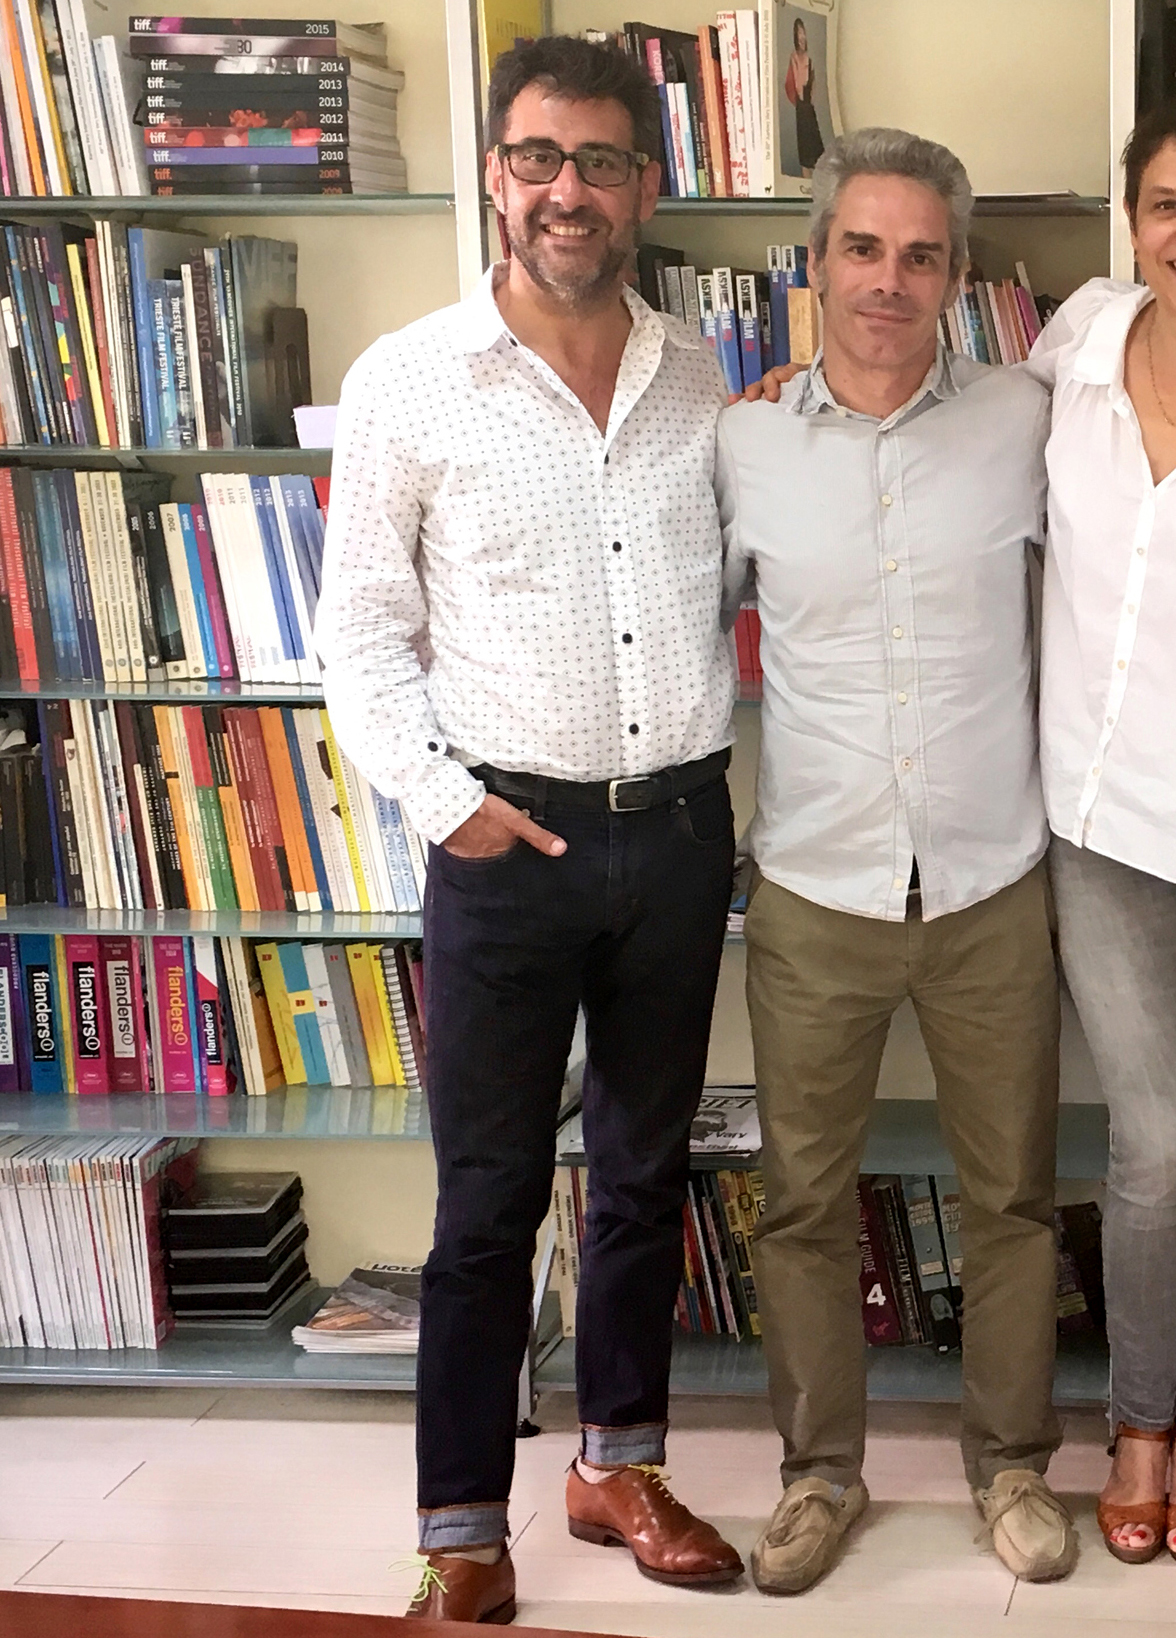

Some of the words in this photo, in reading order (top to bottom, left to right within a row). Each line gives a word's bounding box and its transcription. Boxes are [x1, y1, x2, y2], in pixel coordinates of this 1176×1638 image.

[134, 18, 152, 31] tiff.
[305, 24, 329, 34] 2015
[150, 59, 169, 71] tiff.
[320, 62, 344, 73] 2014
[147, 76, 165, 89] tiff.
[318, 79, 342, 90] 2013
[147, 95, 166, 108] tiff.
[318, 97, 343, 107] 2013
[148, 112, 167, 124] tiff.
[319, 113, 344, 124] 2012
[149, 131, 168, 144] tiff.
[320, 132, 344, 143] 2011
[153, 150, 172, 163] tiff.
[320, 151, 344, 161] 2010
[189, 245, 211, 363] SUNDANCE
[225, 284, 233, 317] VANCOUVER
[152, 297, 164, 331] TRIESTE
[170, 296, 182, 330] TRIESTE
[155, 331, 166, 351] FILM
[173, 330, 184, 351] FILM
[228, 318, 237, 359] INTERNATIONAL
[157, 351, 169, 390] FESTIVAL
[174, 350, 187, 390] FESTIVAL
[233, 375, 241, 400] FESTIVAL
[216, 487, 225, 506] 2010
[226, 487, 235, 504] 2011
[238, 486, 246, 504] 2011
[253, 487, 262, 506] 2012
[263, 487, 273, 506] 2012
[284, 488, 294, 507] 2013
[297, 488, 307, 507] 2013
[130, 515, 139, 531] 2005
[146, 510, 157, 530] 2006
[166, 511, 176, 532] 2007
[196, 513, 206, 532] 2009
[861, 1244, 877, 1274] GUIDE
[866, 1283, 886, 1306] 4
